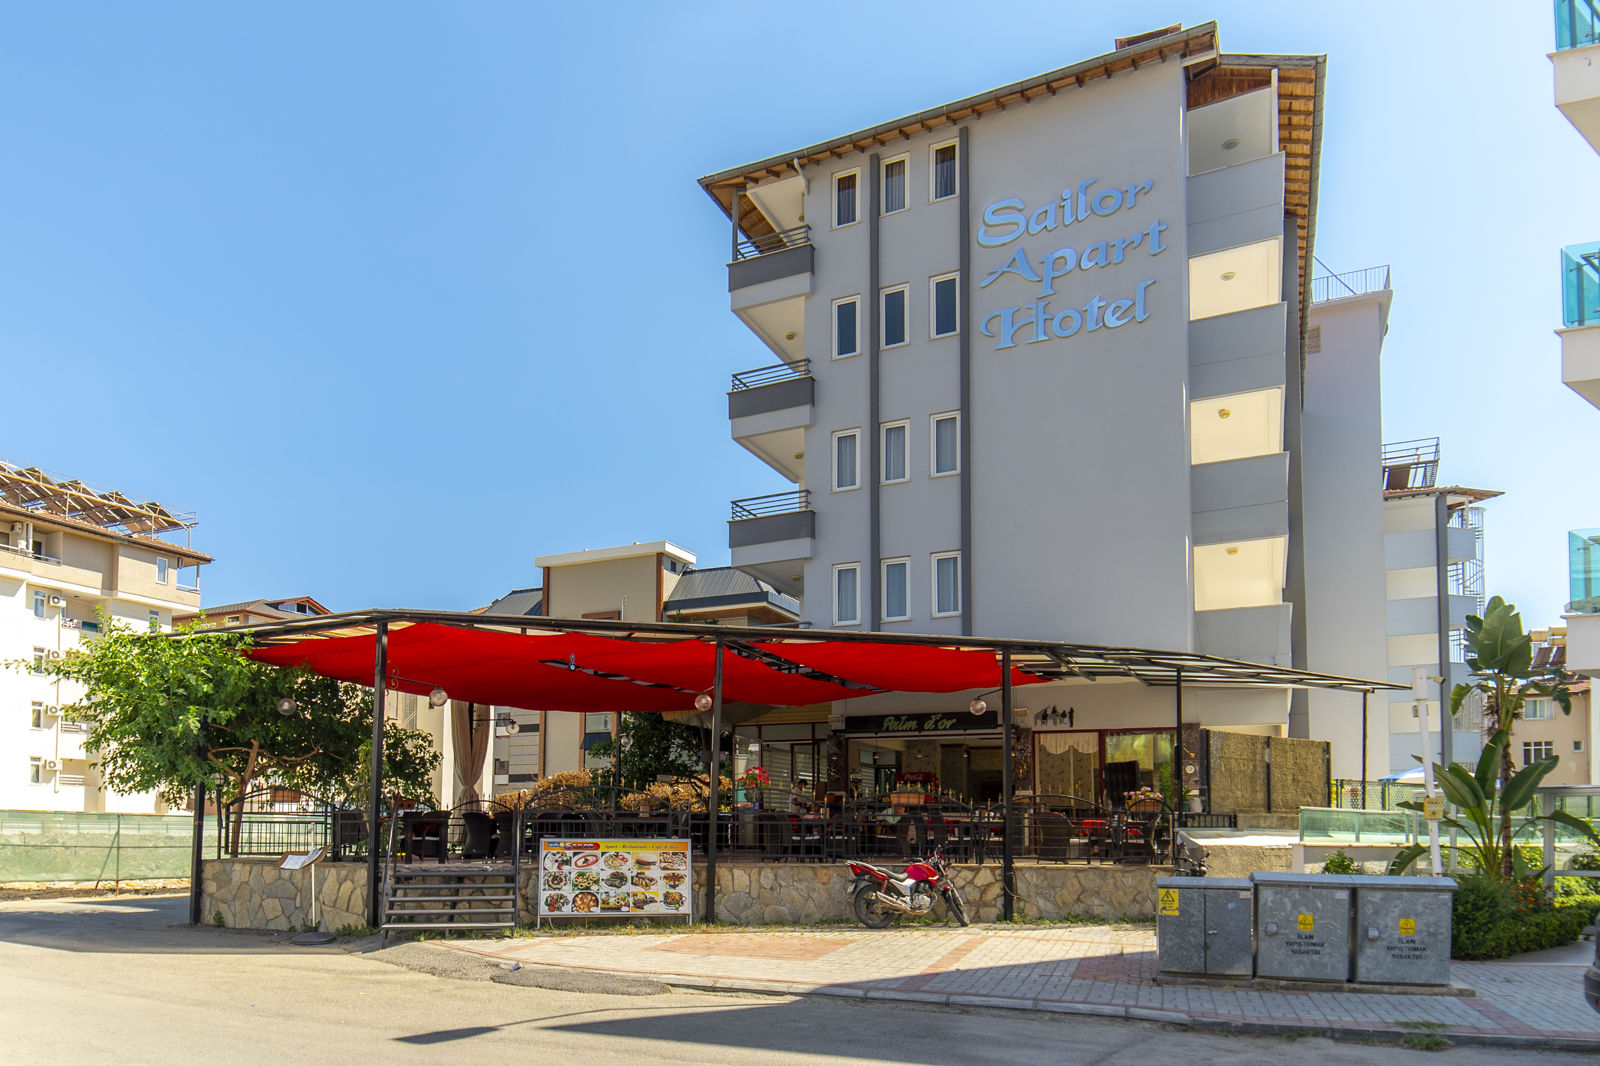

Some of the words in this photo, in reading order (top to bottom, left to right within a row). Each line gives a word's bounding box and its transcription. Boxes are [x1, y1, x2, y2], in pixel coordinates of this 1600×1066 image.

[977, 177, 1154, 248] Sailor
[979, 218, 1169, 300] Apart
[980, 278, 1157, 351] Hotel
